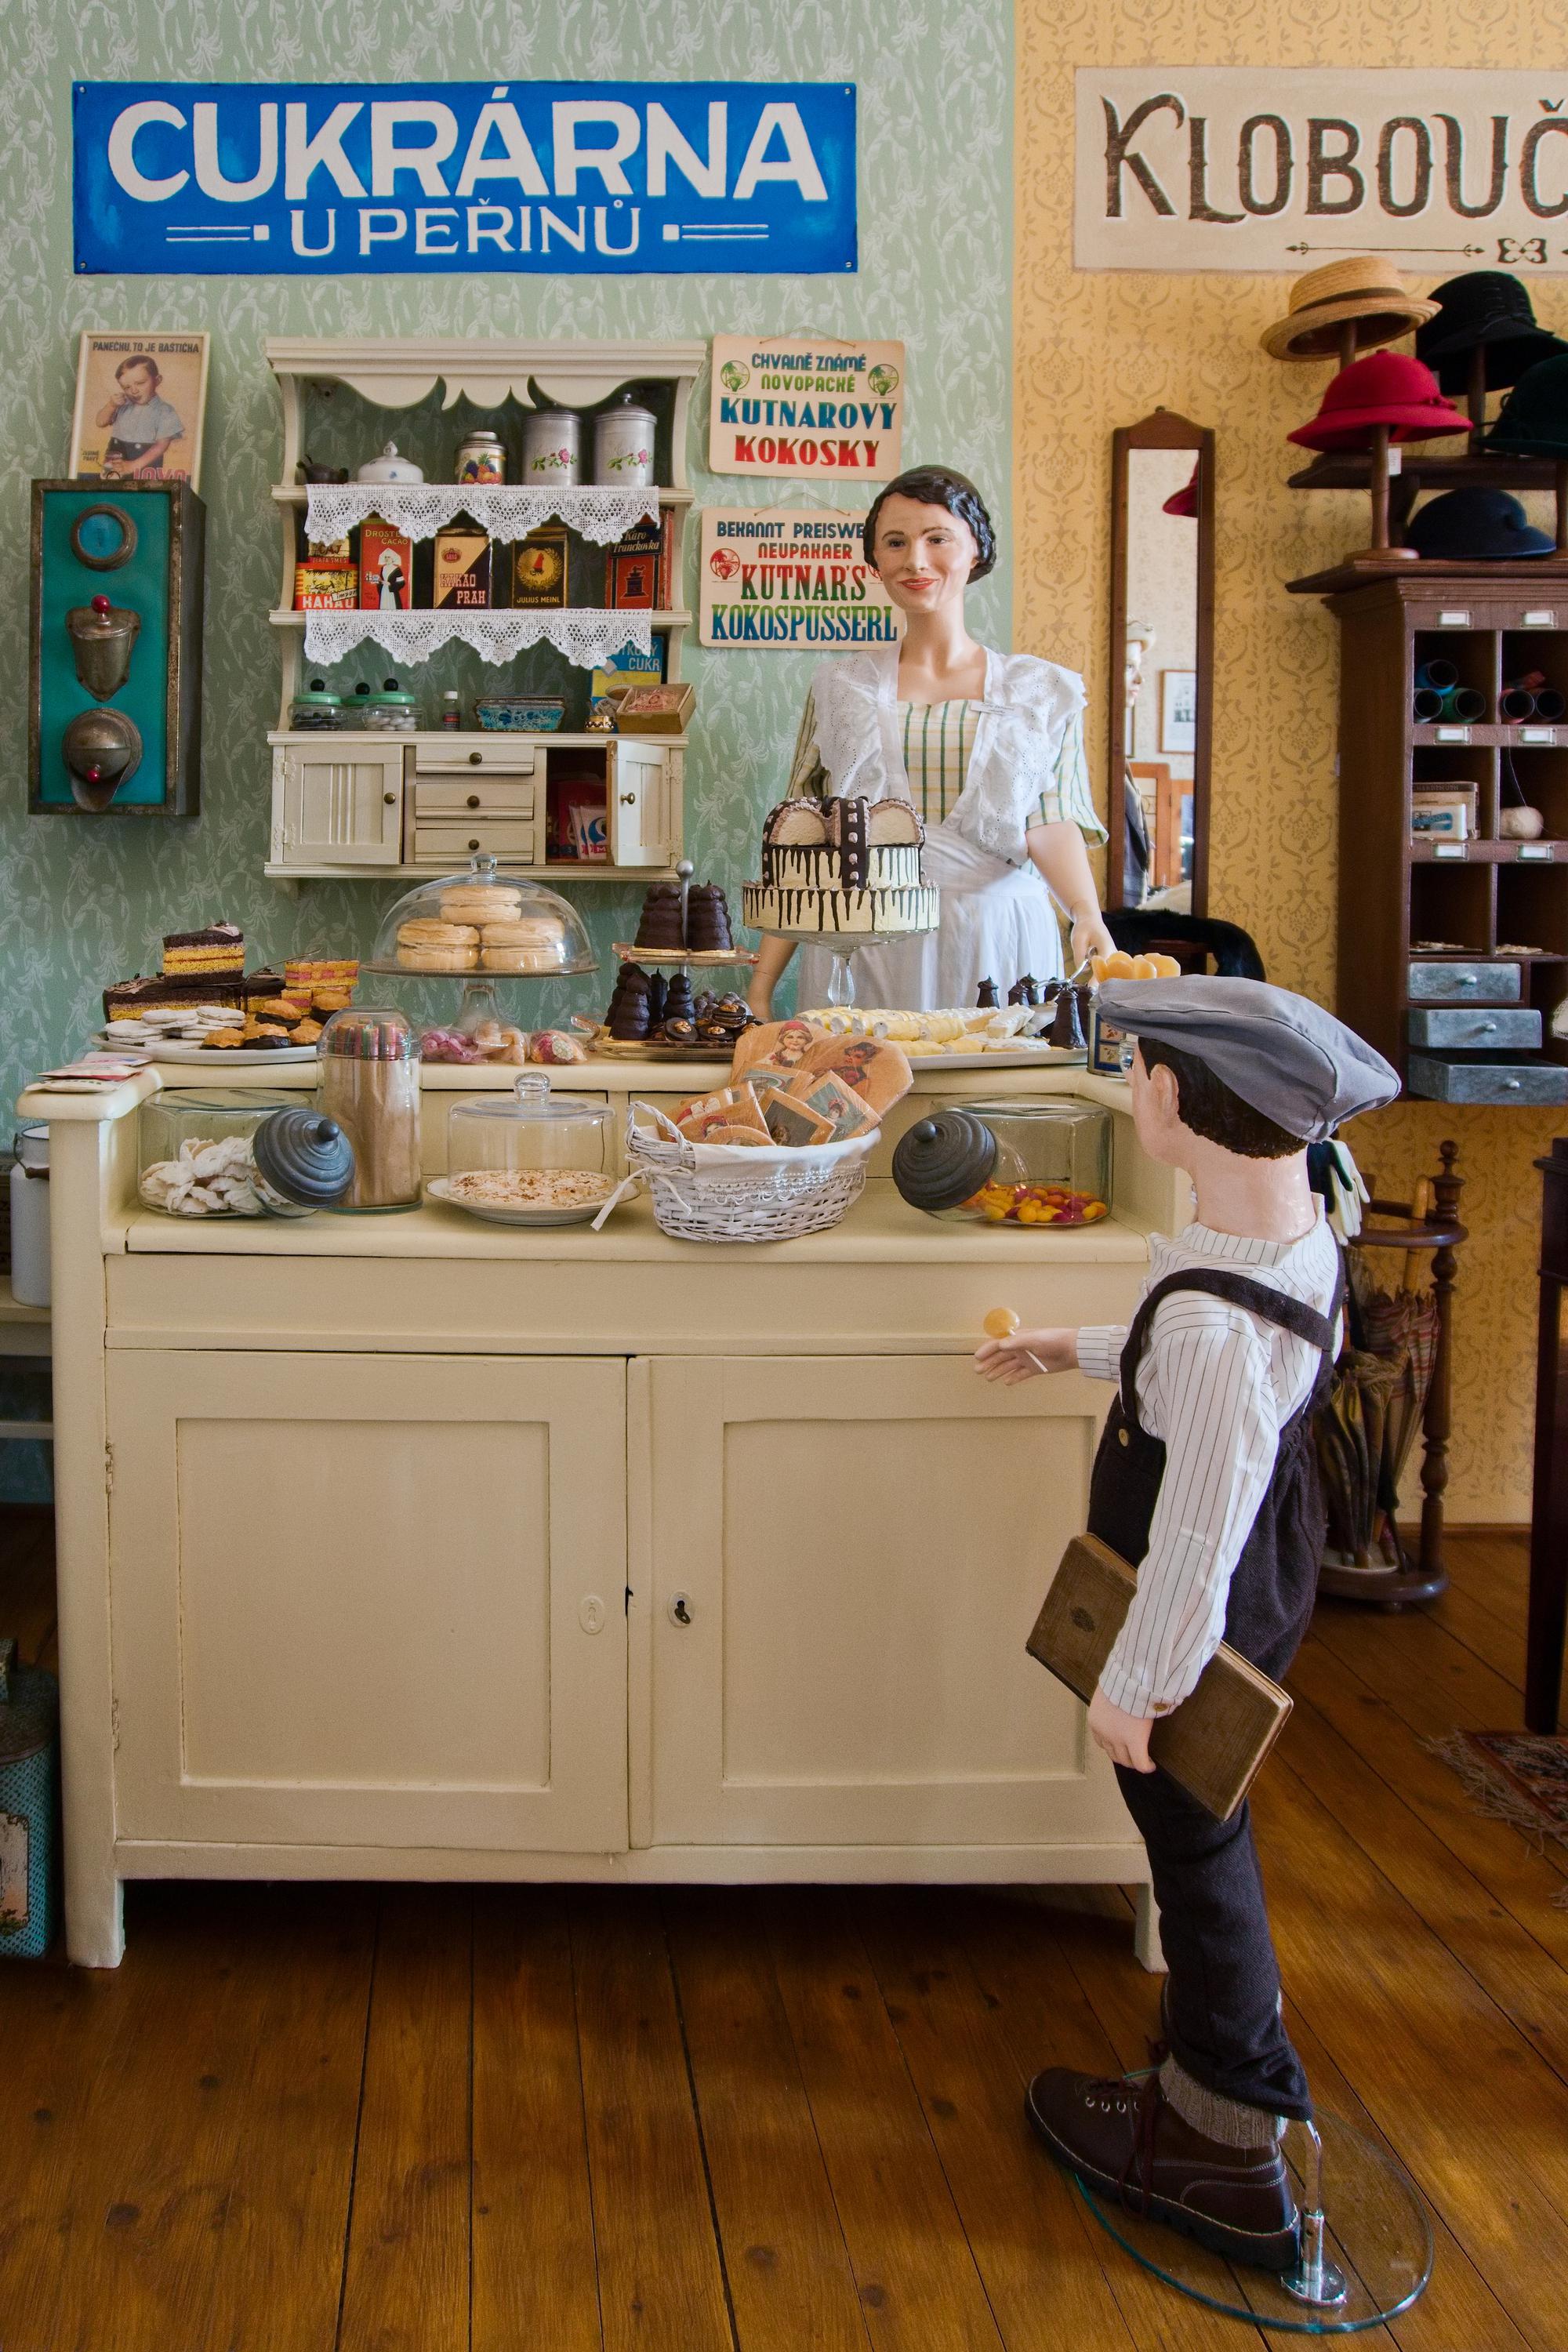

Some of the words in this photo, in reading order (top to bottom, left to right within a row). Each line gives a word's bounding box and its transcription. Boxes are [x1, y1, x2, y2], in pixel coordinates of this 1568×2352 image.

[107, 86, 827, 201] CUKRÁRNA
[291, 209, 336, 256] U
[358, 197, 641, 256] PEŘINŮ
[133, 343, 143, 352] TO
[145, 343, 155, 352] JE
[752, 352, 812, 371] CHVALNĚ
[816, 353, 866, 372] ZNÁMÉ
[760, 373, 856, 393] NOVOPACKÉ
[720, 396, 897, 430] KUTNAROVY
[734, 434, 880, 467] KOKOSKY
[365, 529, 400, 538] DROSTE
[717, 521, 786, 539] BEKANNT
[793, 522, 864, 539] PREISWE
[757, 542, 853, 560] NEUPAKAER
[439, 573, 476, 588] KAKAO
[741, 564, 866, 601] KUTNAR'S
[456, 590, 486, 604] PRAH
[710, 604, 898, 641] KOKOSPUSSERL
[628, 657, 660, 671] CUKR
